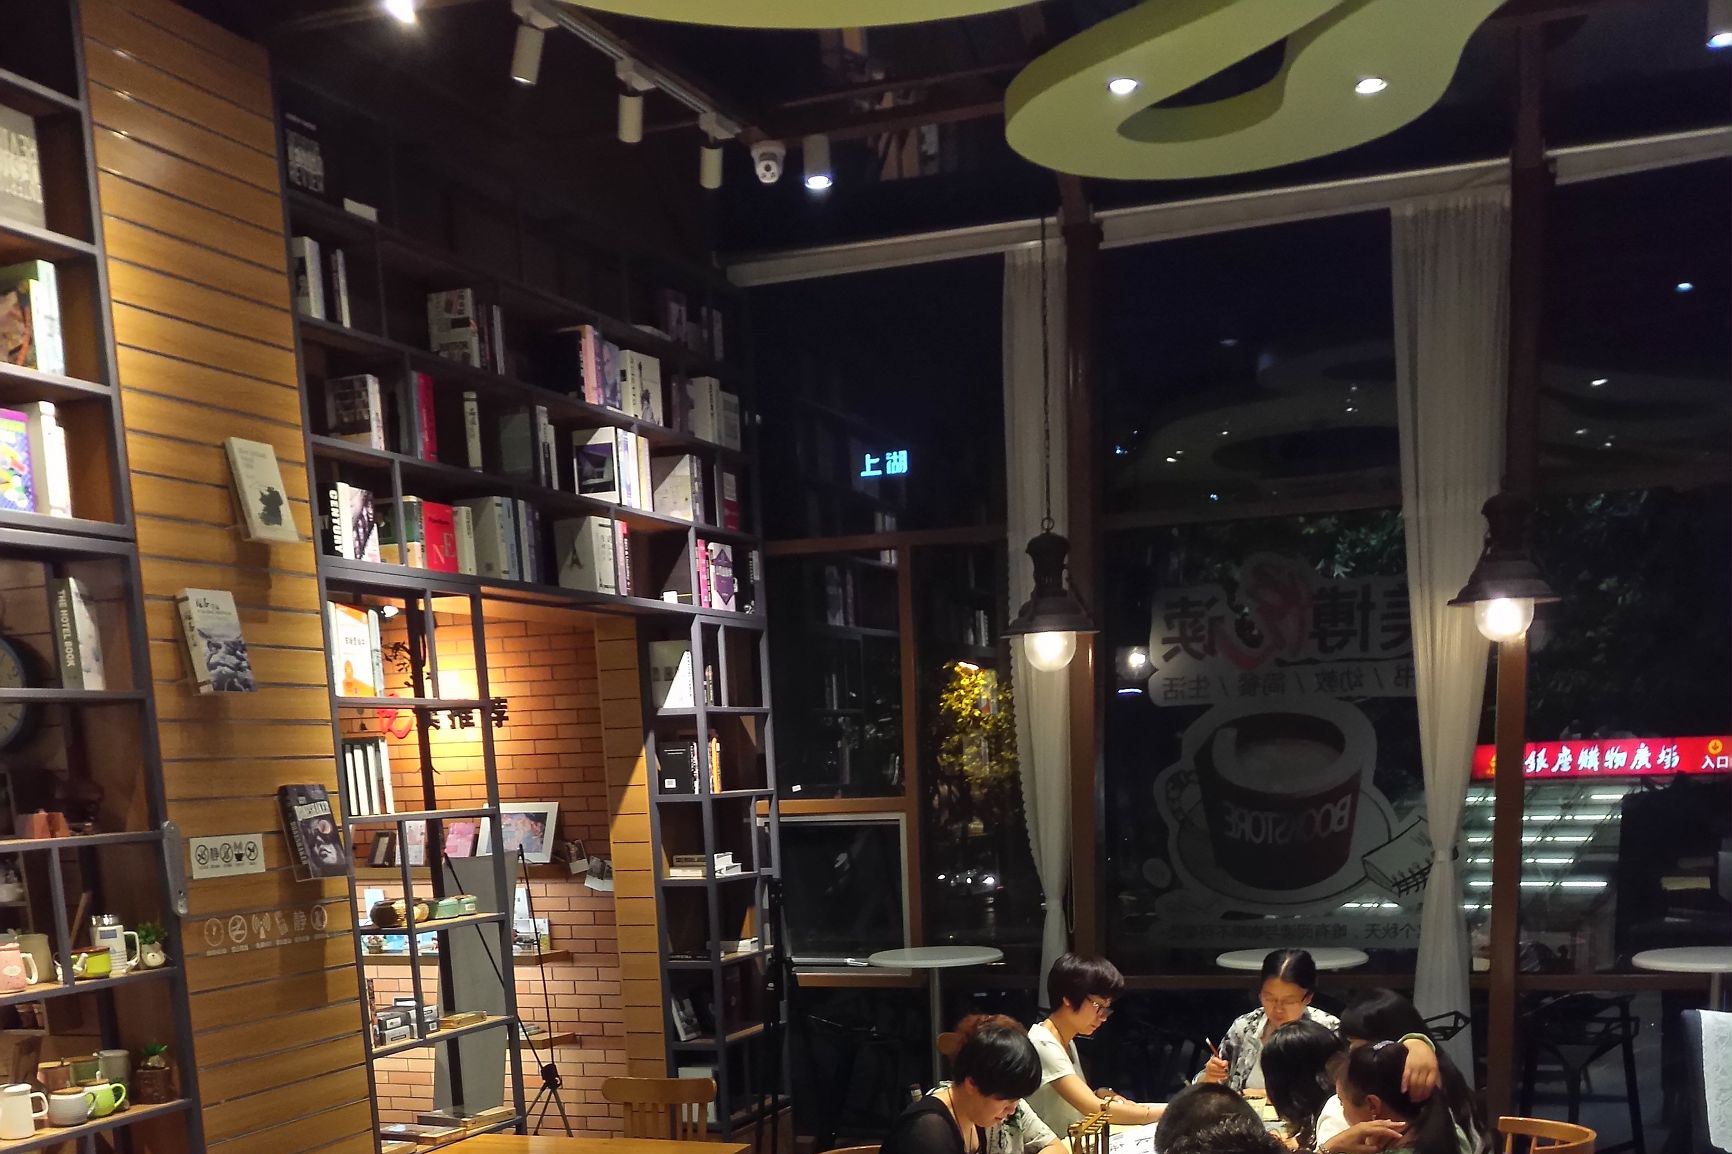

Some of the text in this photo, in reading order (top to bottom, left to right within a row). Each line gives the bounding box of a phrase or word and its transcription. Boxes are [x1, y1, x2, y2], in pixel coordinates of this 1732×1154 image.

[328, 489, 343, 553] CENTURY
[58, 589, 76, 667] THE HOTEL BOOK
